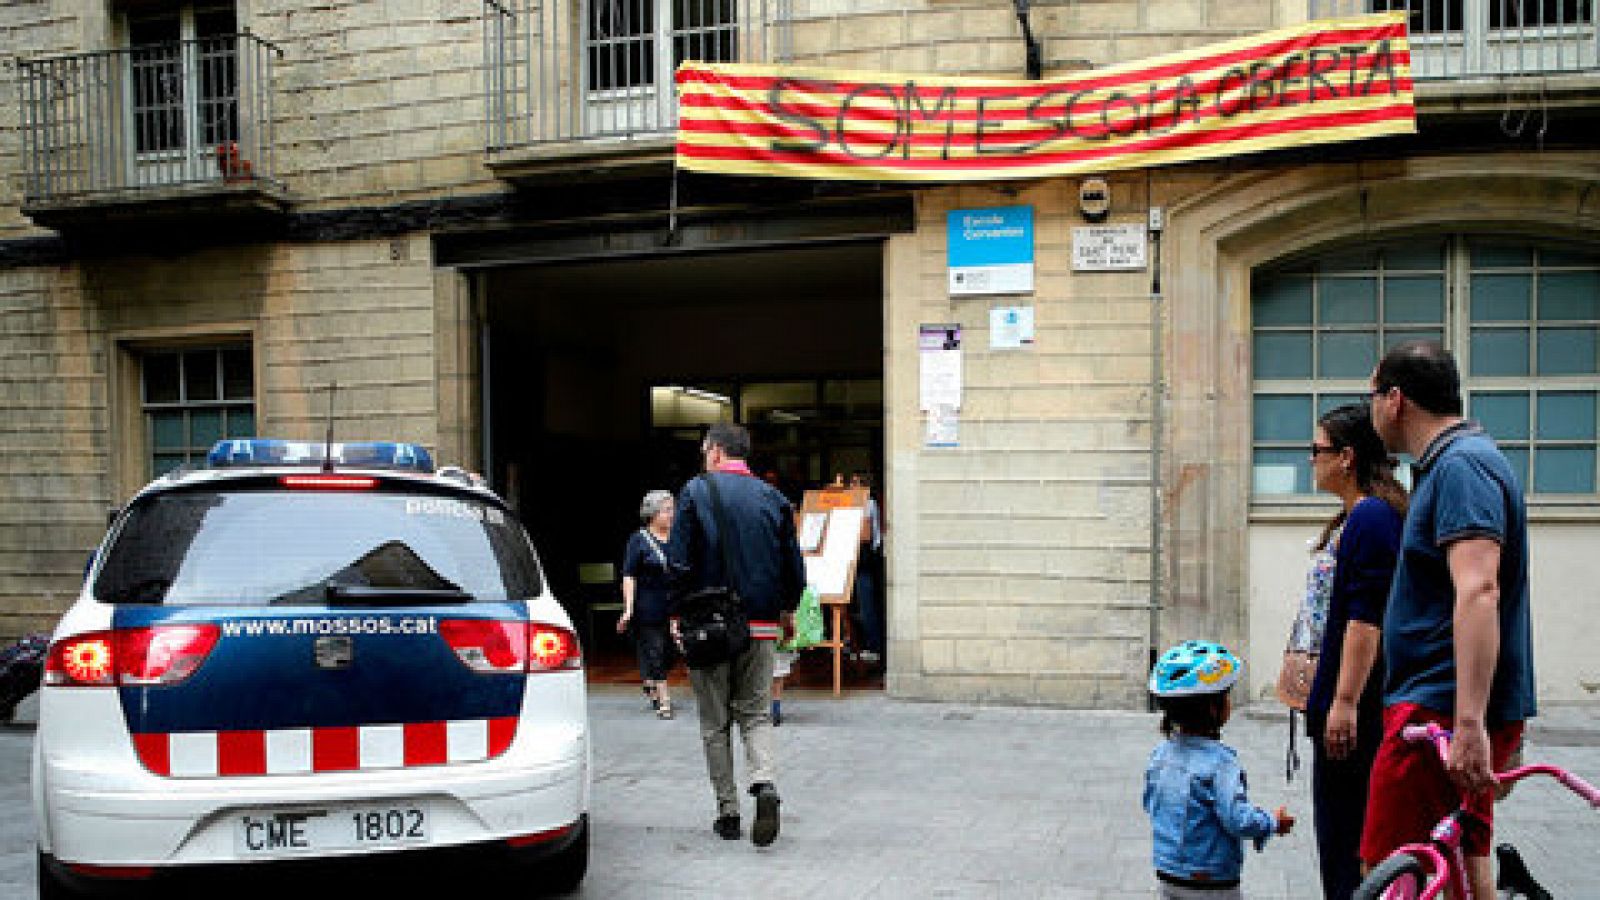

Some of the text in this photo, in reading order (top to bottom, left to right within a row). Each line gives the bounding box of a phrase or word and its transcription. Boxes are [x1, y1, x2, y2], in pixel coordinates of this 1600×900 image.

[769, 39, 1398, 161] SOM ESCOLA OBERTA
[222, 616, 438, 637] www.mossos.cat
[245, 809, 424, 851] CME 1802
